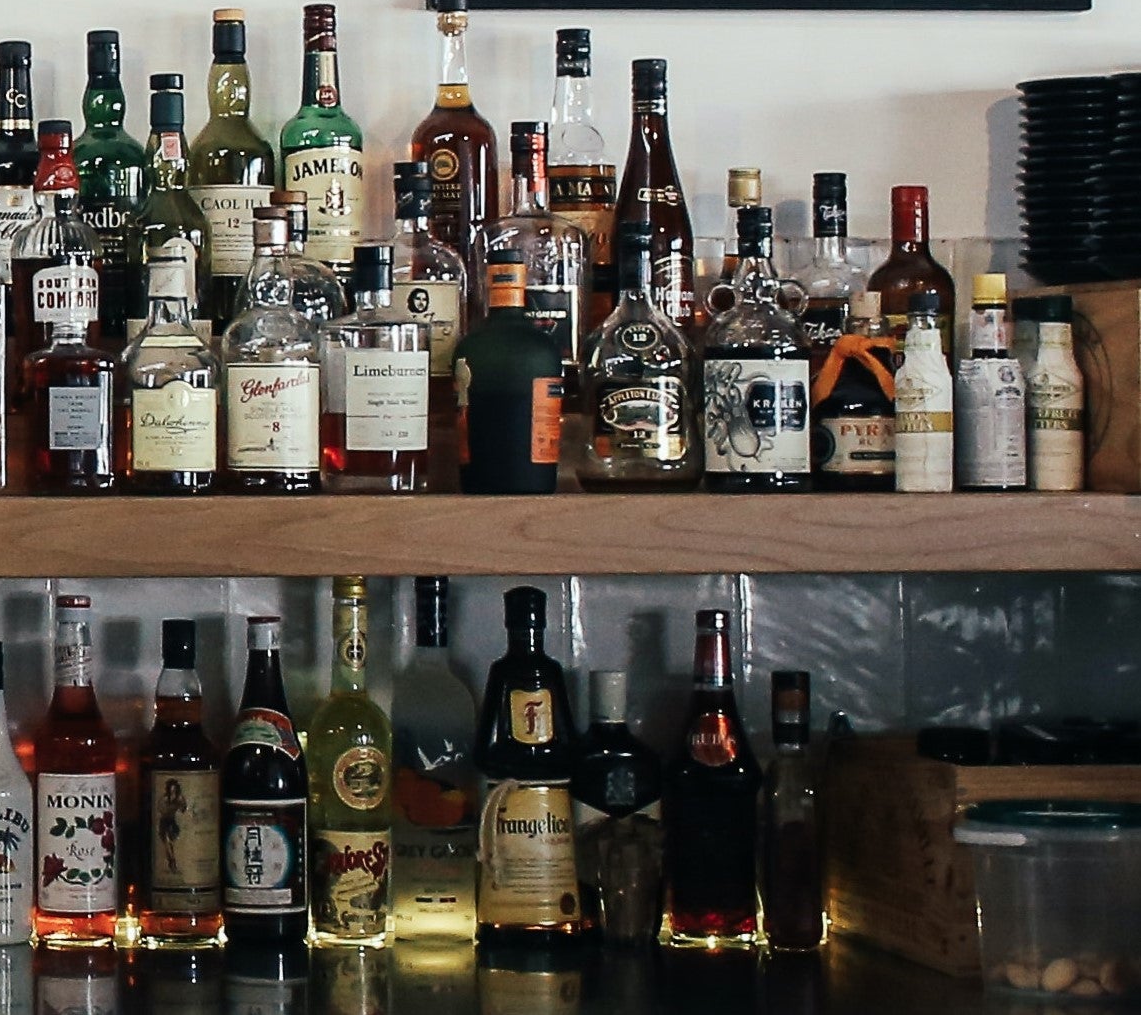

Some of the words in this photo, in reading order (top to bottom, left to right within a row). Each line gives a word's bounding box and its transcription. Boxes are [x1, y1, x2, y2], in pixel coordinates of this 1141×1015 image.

[293, 157, 363, 182] JAMEON
[200, 197, 240, 211] CAOL
[226, 217, 241, 229] 12
[47, 794, 113, 810] MONIN
